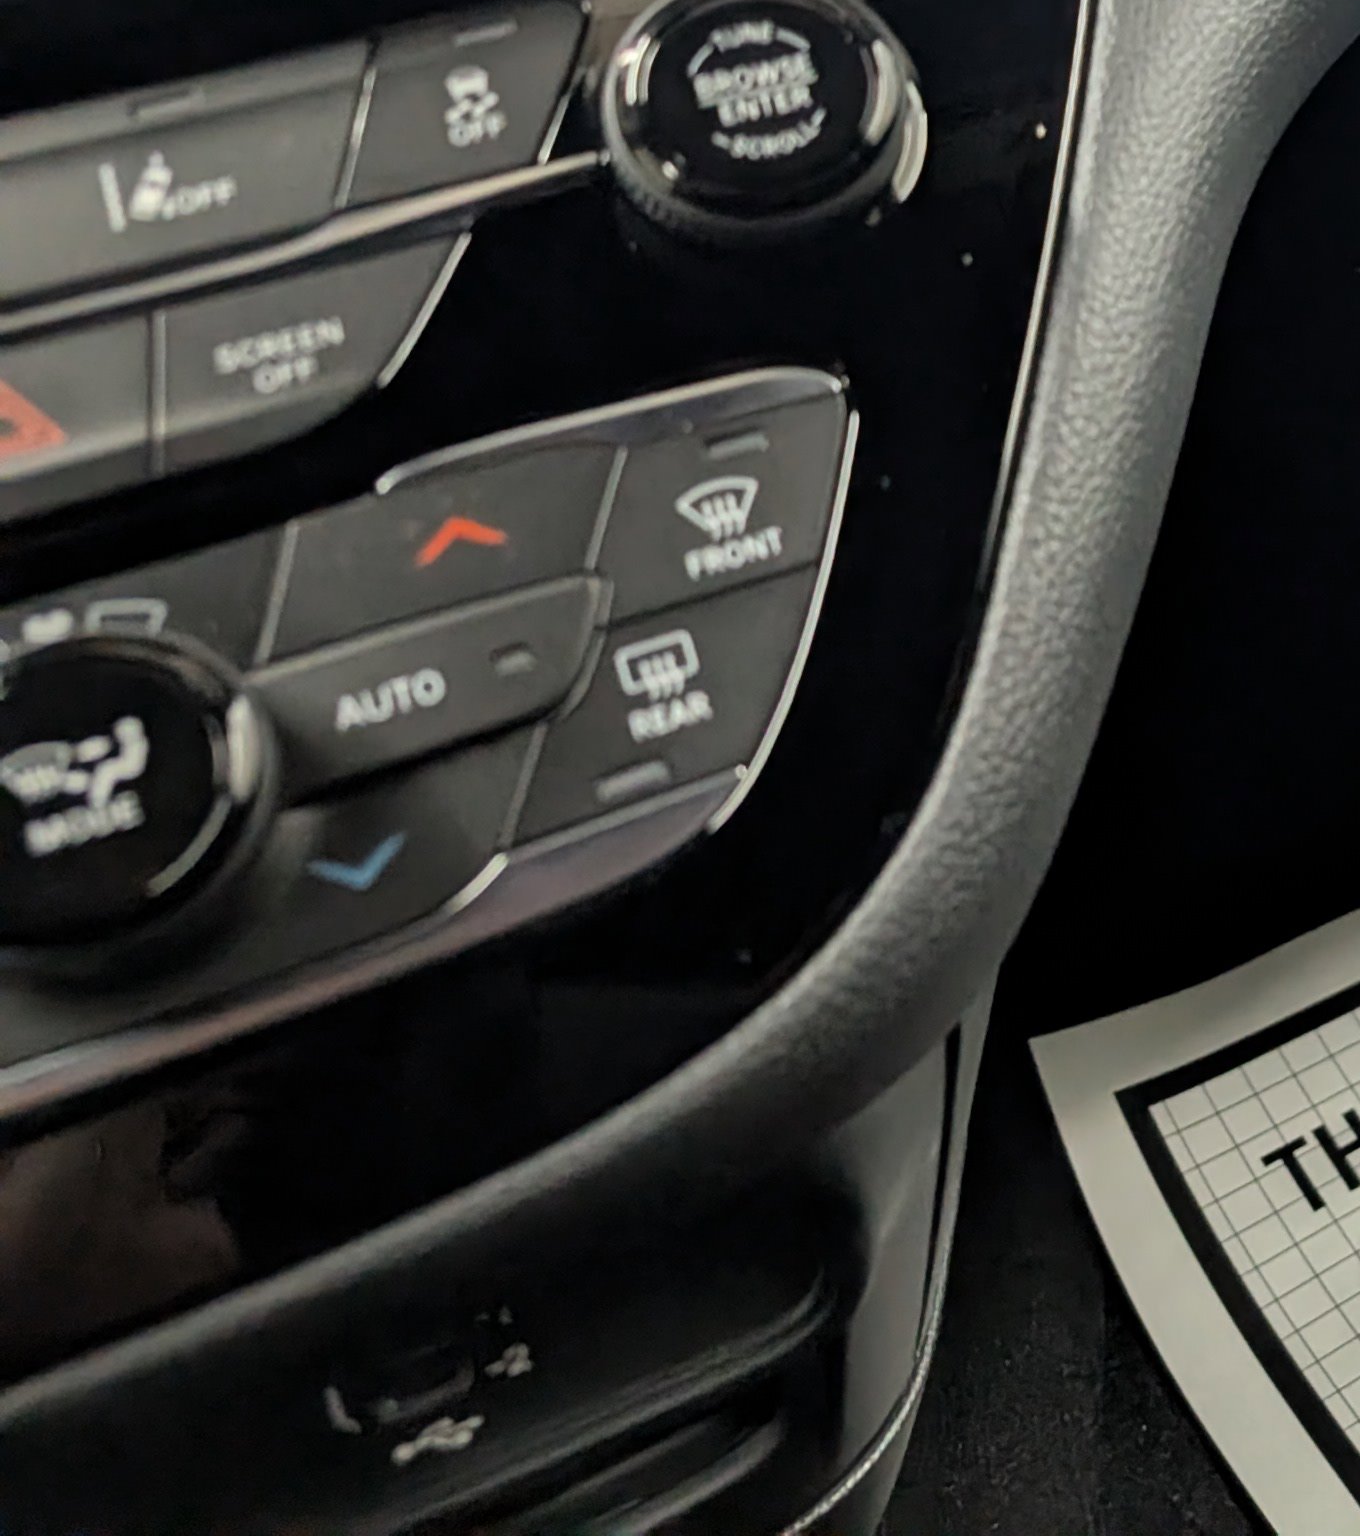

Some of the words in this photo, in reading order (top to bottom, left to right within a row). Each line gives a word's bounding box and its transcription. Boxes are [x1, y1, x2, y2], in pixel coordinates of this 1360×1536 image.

[693, 52, 819, 109] BROWSE
[717, 84, 813, 127] ENTER
[446, 110, 508, 148] OFF
[178, 175, 238, 216] OFF
[213, 314, 345, 375] SCREEN
[252, 356, 318, 395] OFF
[684, 526, 782, 582] FRONT
[336, 667, 446, 733] AUTO
[628, 690, 713, 743] REAR
[24, 790, 145, 856] MODE
